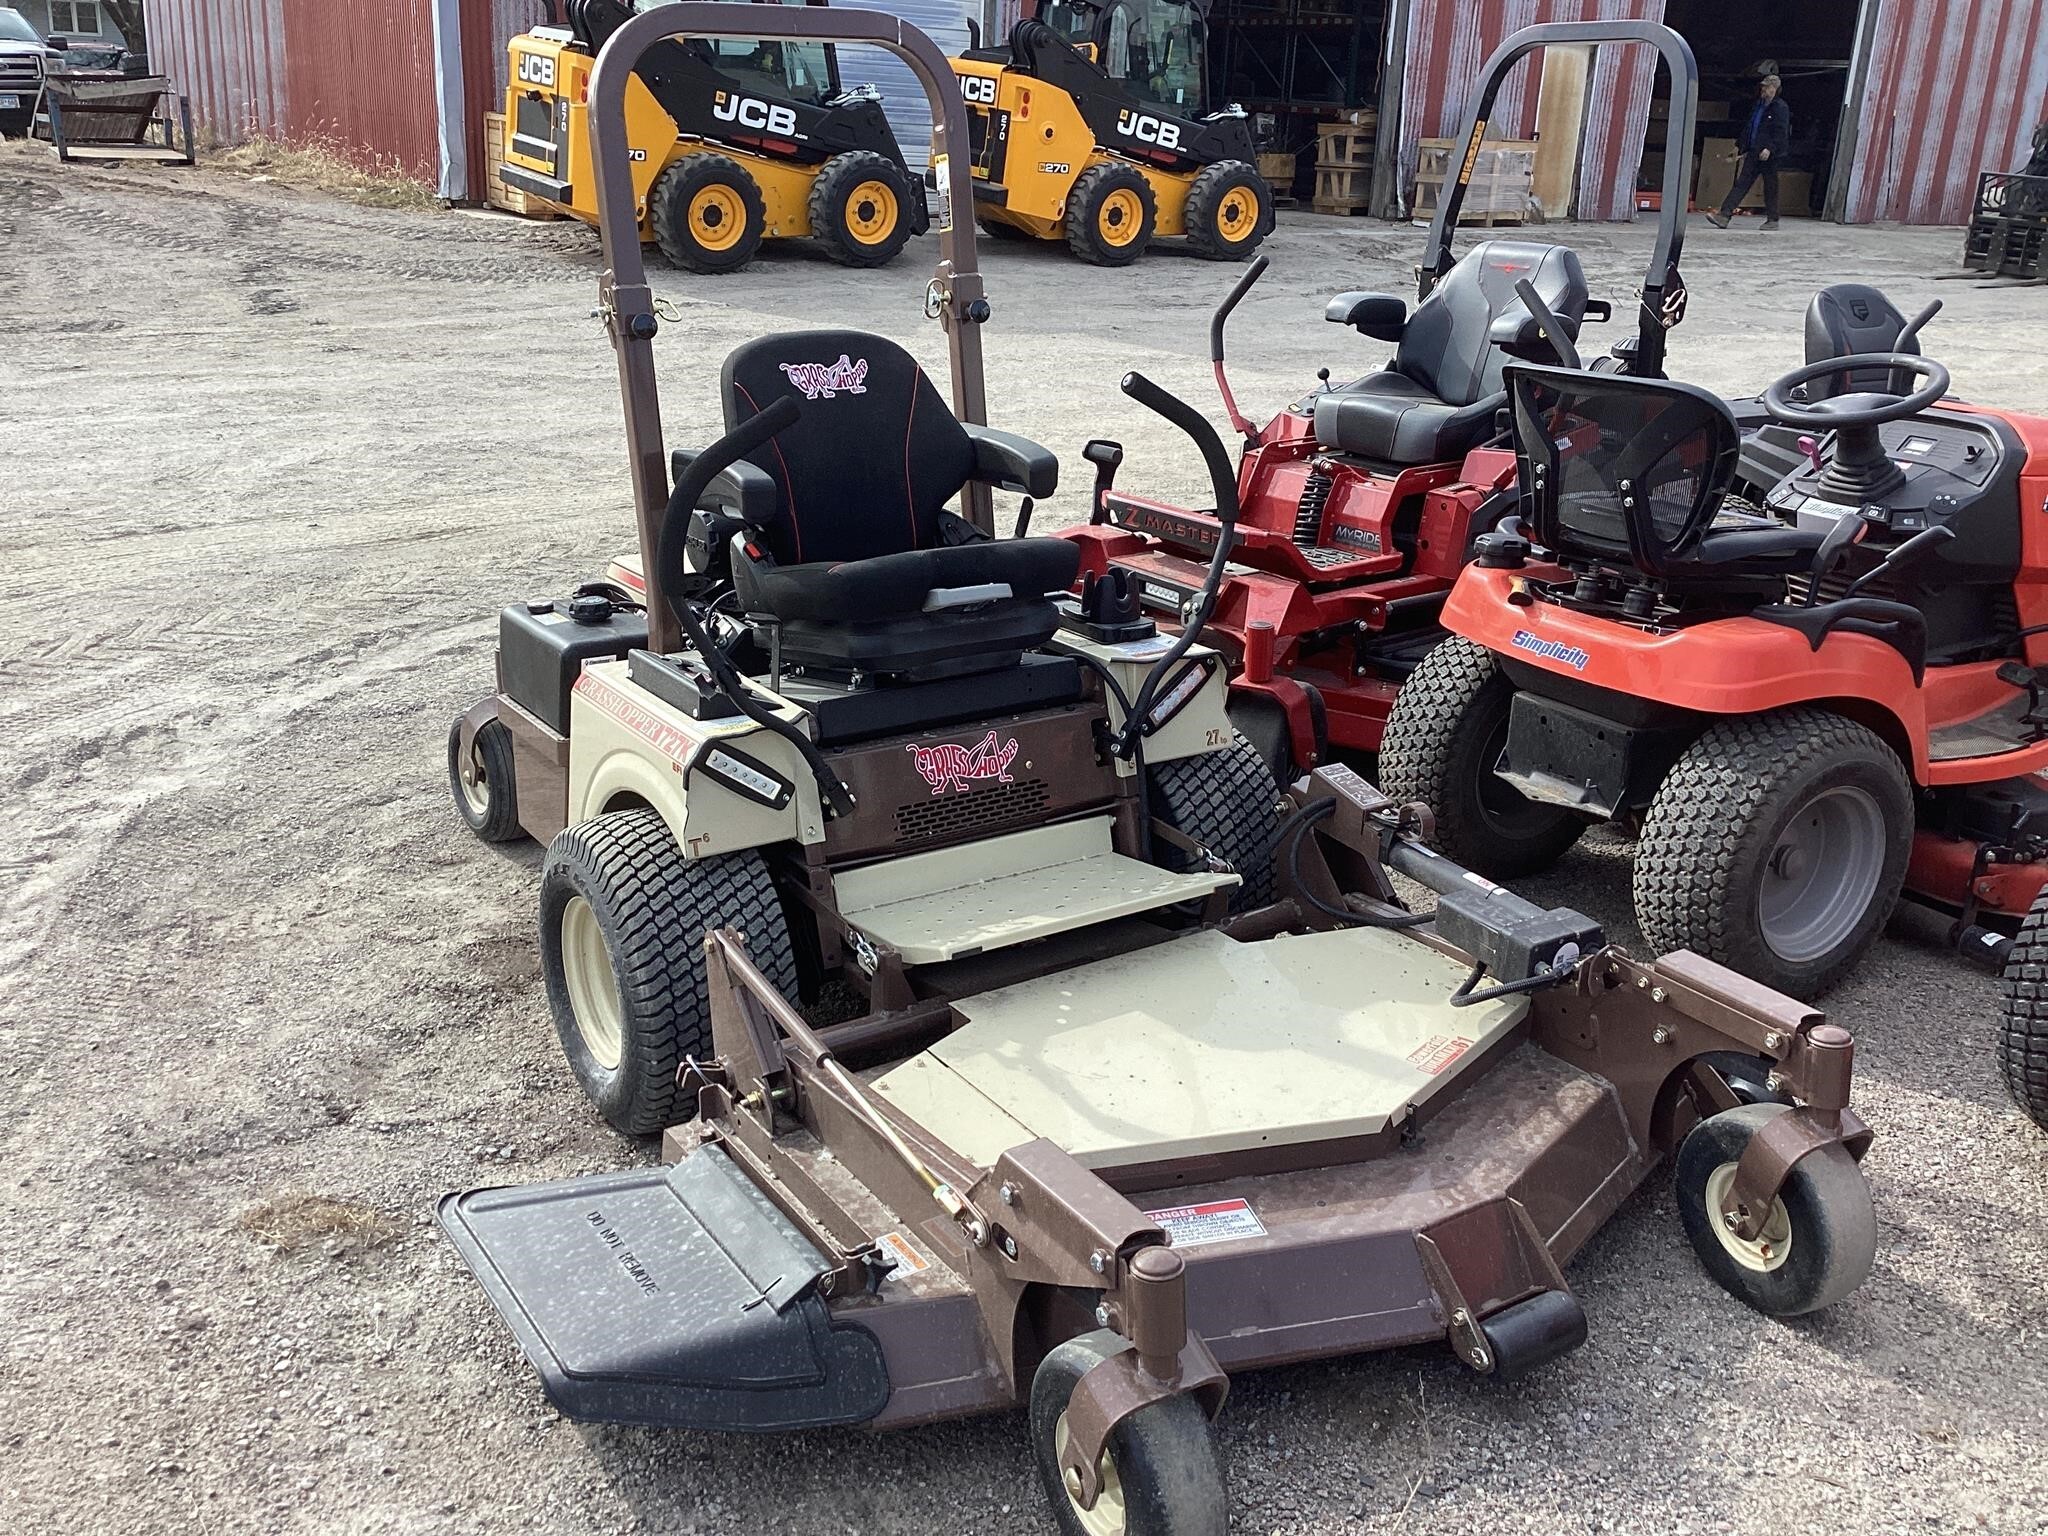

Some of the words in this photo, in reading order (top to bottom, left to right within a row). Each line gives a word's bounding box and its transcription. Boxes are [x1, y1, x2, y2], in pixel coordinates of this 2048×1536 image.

[519, 53, 555, 86] JCB
[713, 94, 797, 136] JCB
[999, 114, 1008, 140] 270
[1117, 112, 1181, 149] JCB
[1044, 163, 1069, 173] 270
[1124, 508, 1142, 528] Z
[1512, 630, 1588, 670] Simplicity
[578, 677, 660, 739] GRASSHOPPER
[659, 726, 695, 763] 727K
[1450, 1035, 1475, 1049] 61
[586, 1211, 606, 1227] DO
[600, 1227, 625, 1249] NOT
[618, 1251, 660, 1297] REMOVE
